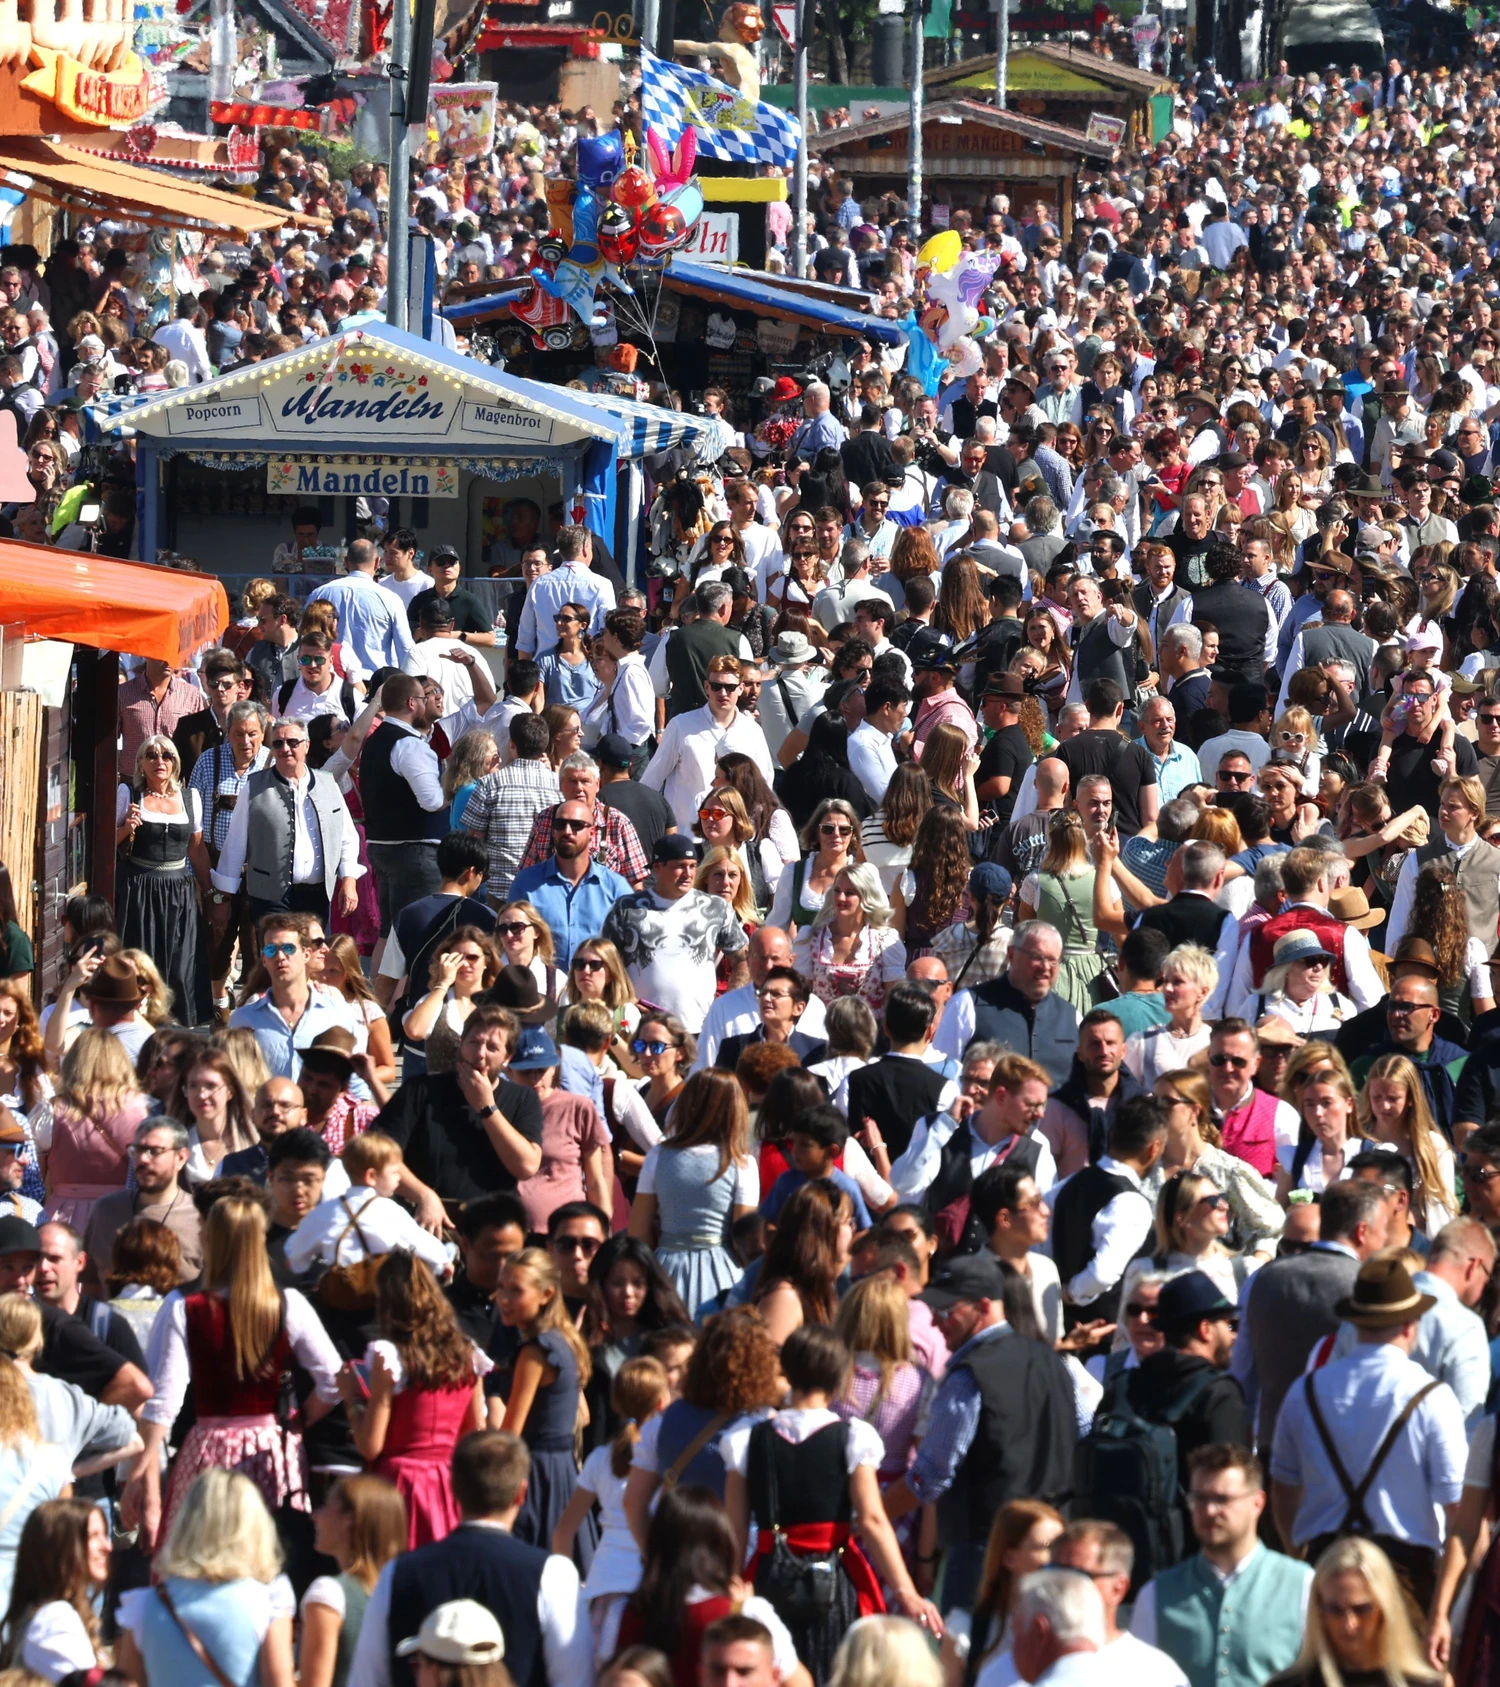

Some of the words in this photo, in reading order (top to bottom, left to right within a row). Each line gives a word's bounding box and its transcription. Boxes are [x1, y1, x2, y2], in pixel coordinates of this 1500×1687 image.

[185, 404, 242, 421] Popcorn
[281, 384, 445, 425] Mandeln
[474, 406, 542, 430] Magenbrot
[296, 465, 431, 496] Mandeln
[1012, 831, 1047, 856] Street
